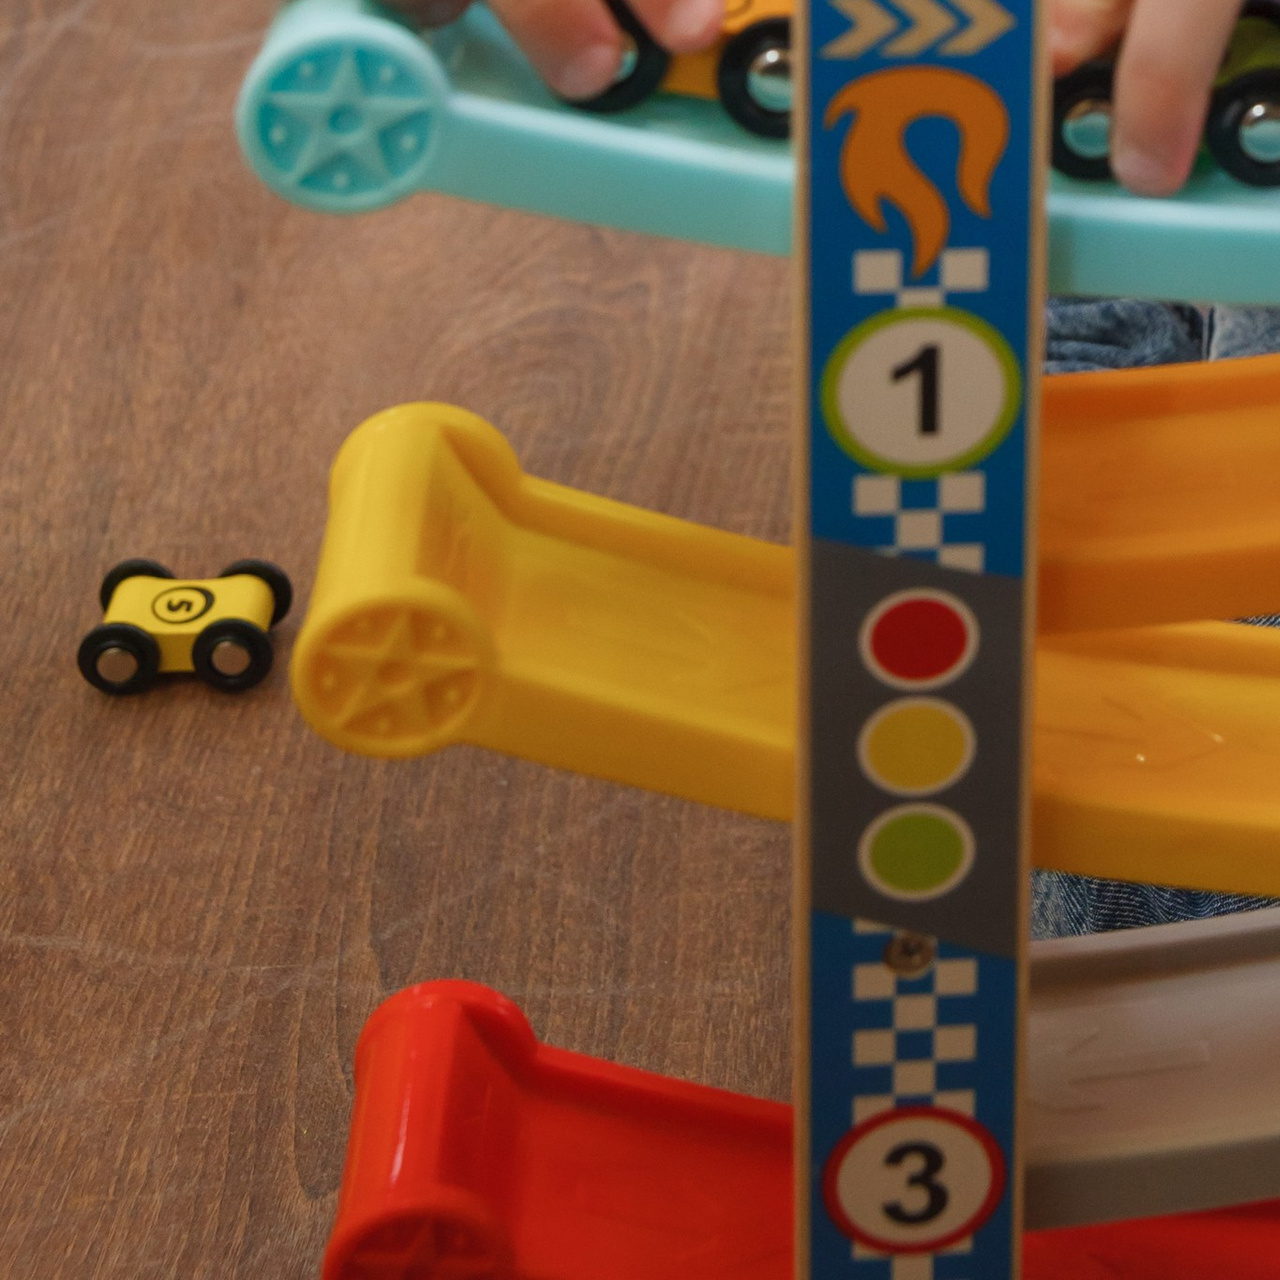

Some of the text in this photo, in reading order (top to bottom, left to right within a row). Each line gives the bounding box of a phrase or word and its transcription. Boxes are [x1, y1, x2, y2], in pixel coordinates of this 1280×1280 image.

[891, 343, 940, 436] 1
[167, 599, 193, 612] 5
[882, 1141, 949, 1226] 3
